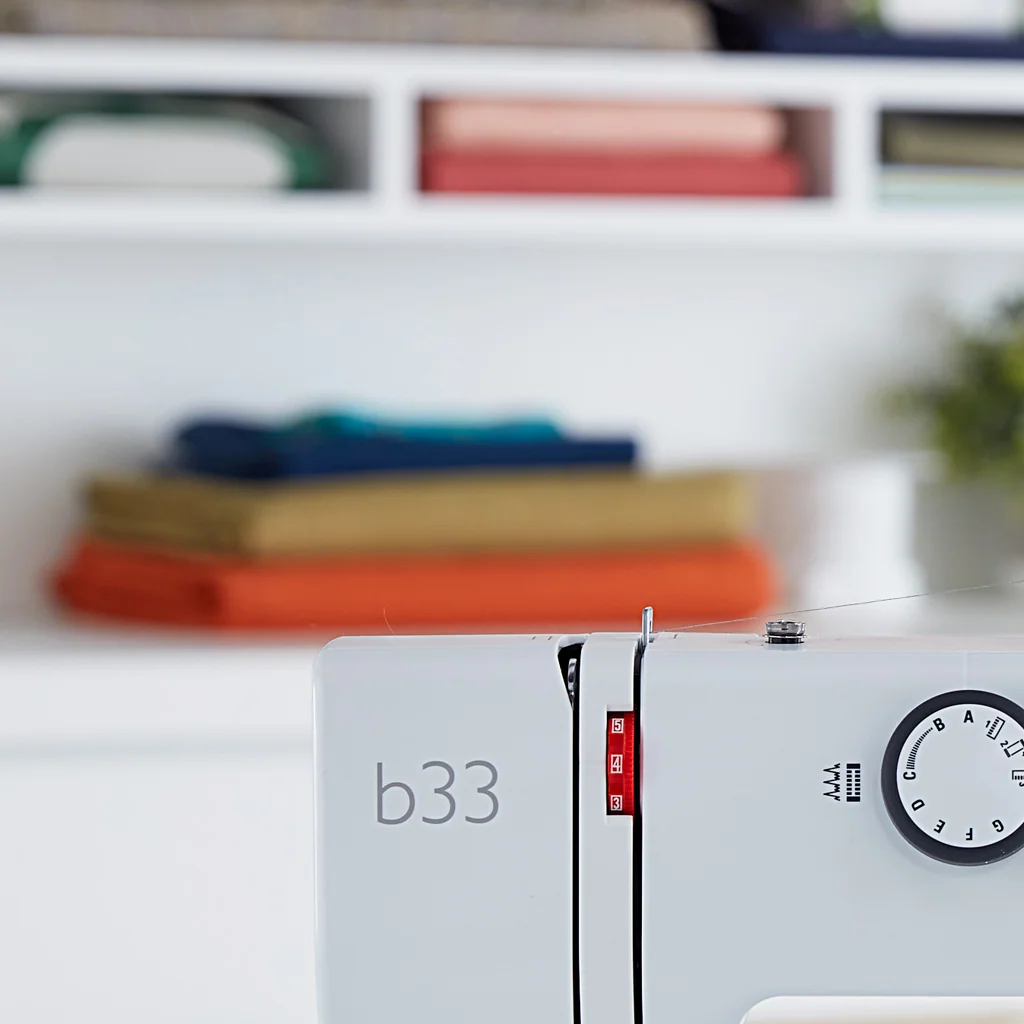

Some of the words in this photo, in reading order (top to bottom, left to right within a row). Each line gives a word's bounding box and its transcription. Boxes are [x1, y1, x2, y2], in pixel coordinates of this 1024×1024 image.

[963, 709, 975, 724] A
[614, 720, 622, 732] 5
[932, 717, 946, 732] B
[612, 755, 621, 772] 4
[902, 771, 917, 781] C
[376, 760, 499, 825] b33
[612, 796, 620, 810] 3
[911, 799, 925, 812] D
[933, 819, 946, 834] E
[991, 819, 1005, 833] G
[965, 827, 973, 841] F
